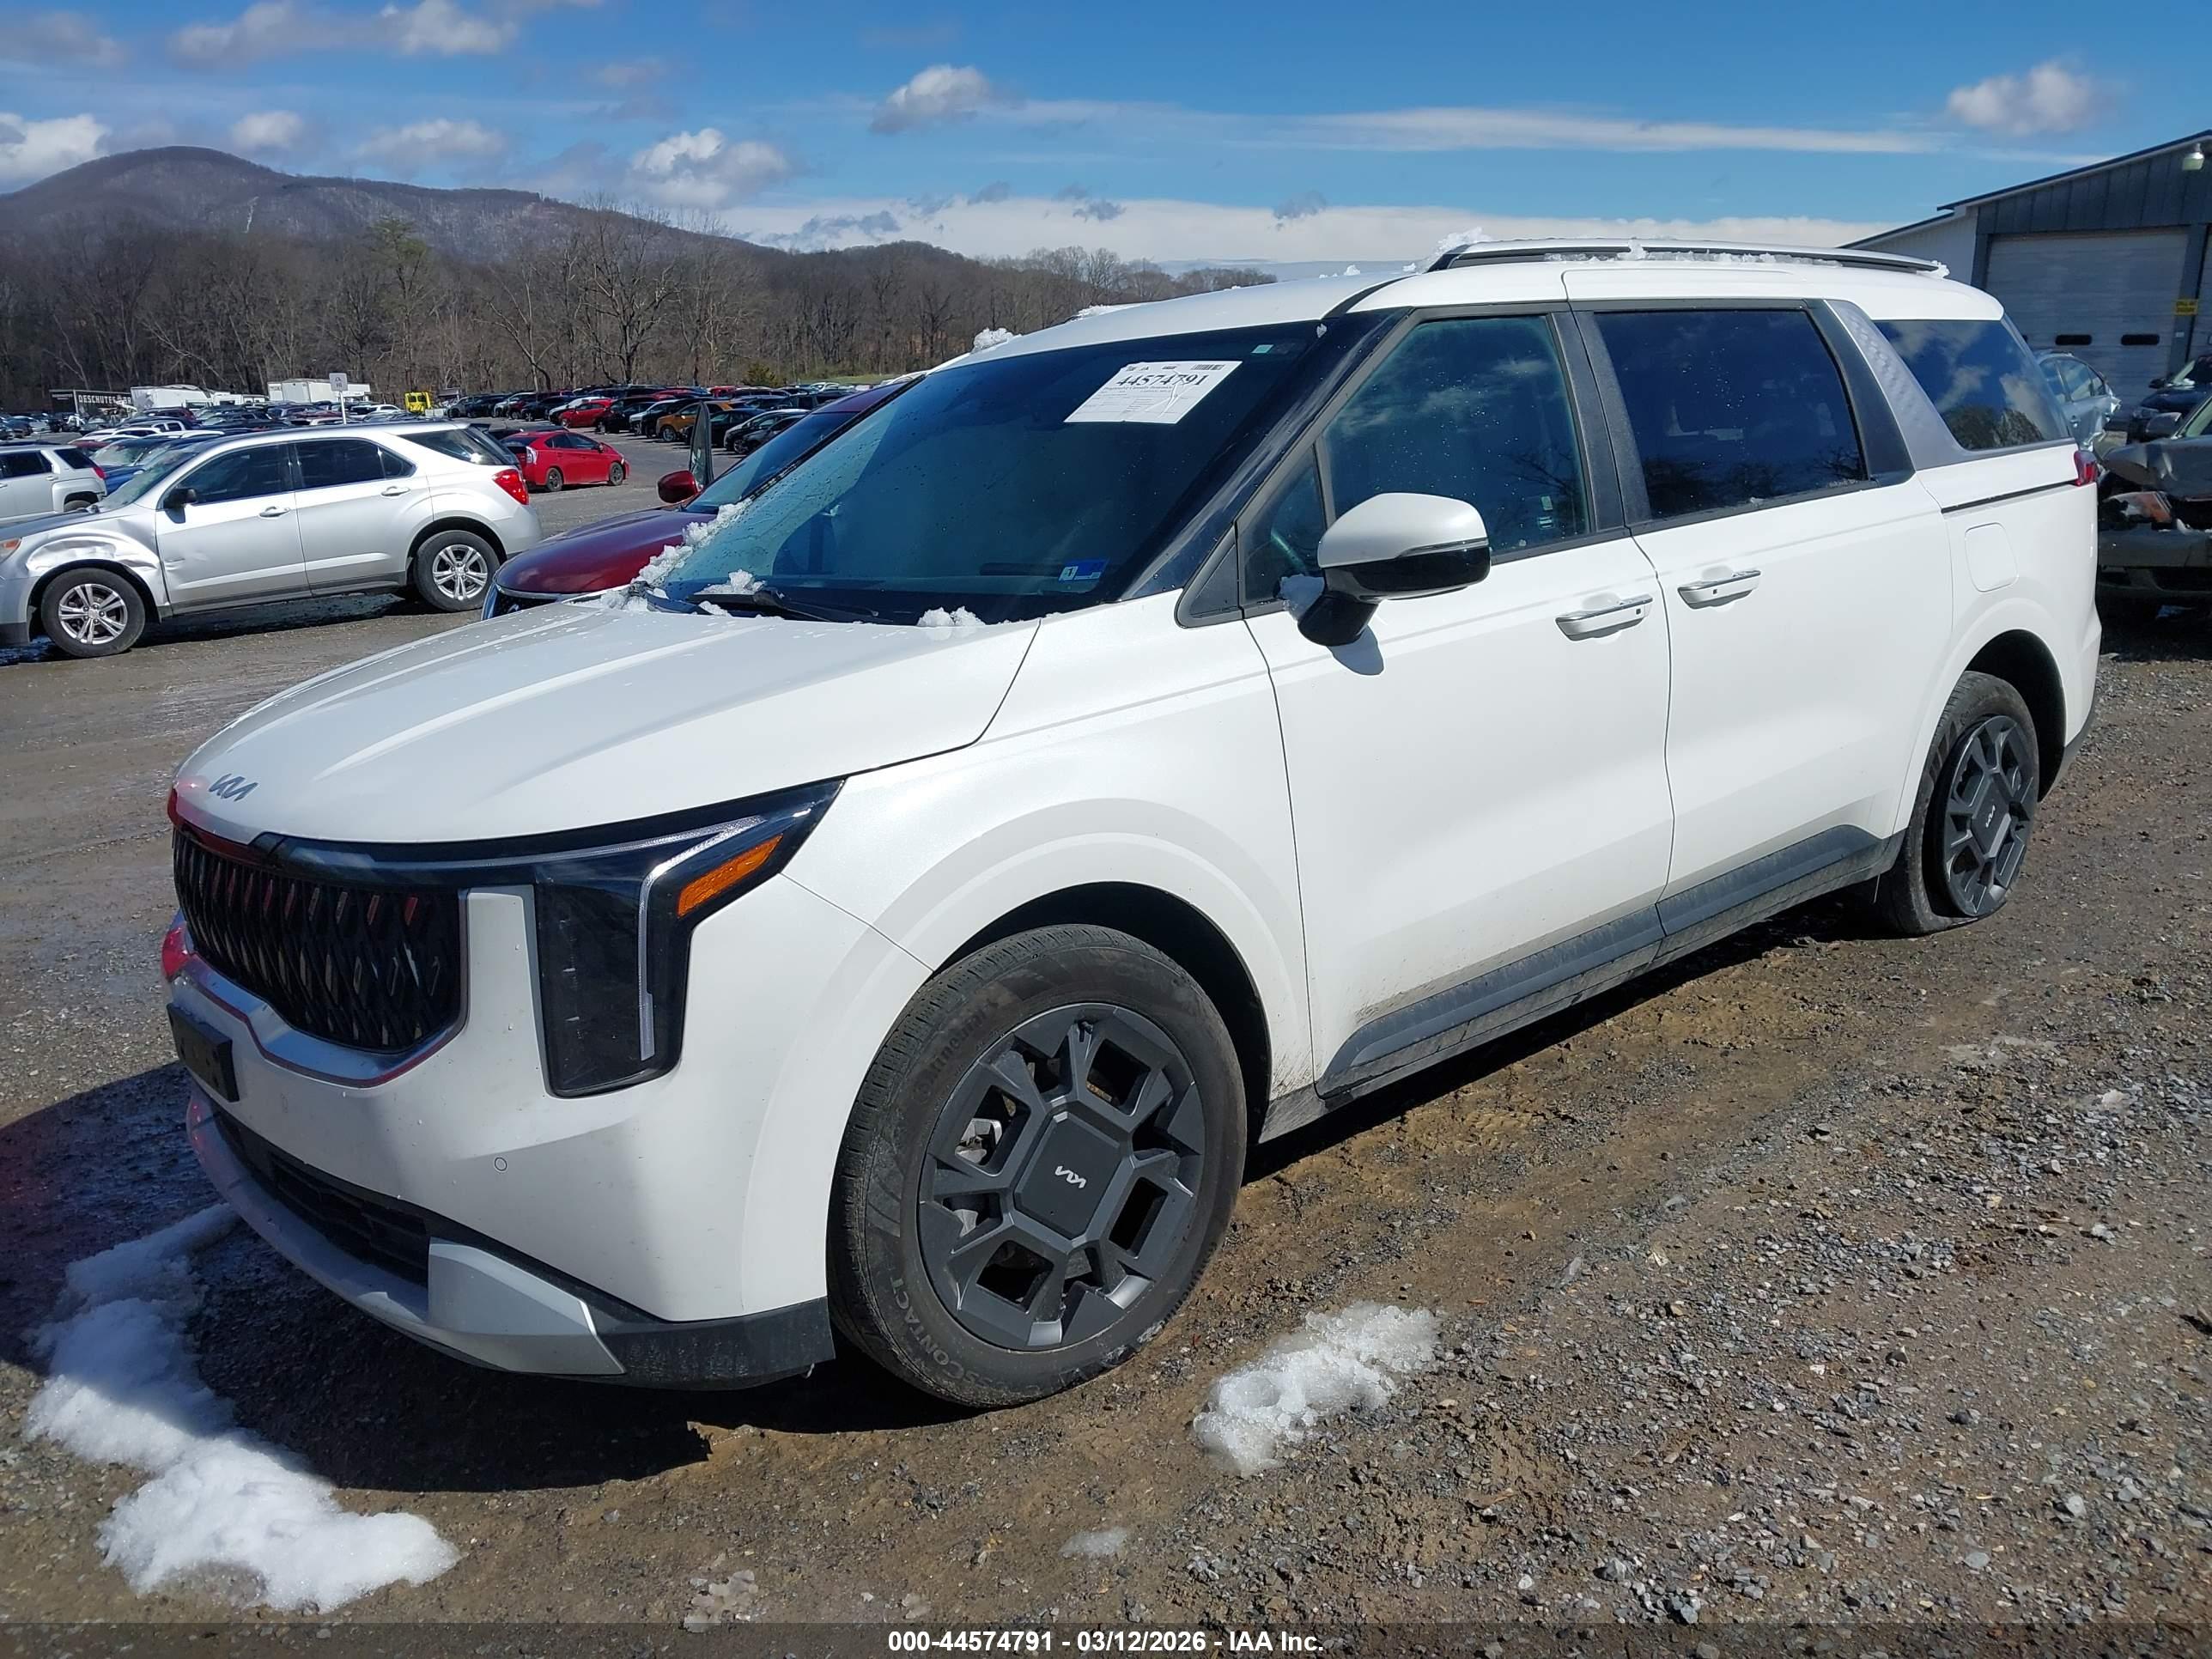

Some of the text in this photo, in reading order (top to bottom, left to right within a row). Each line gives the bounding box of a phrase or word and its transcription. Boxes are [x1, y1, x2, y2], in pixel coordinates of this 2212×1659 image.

[1116, 374, 1209, 386] 44574791
[78, 395, 117, 404] DESCHUTES
[209, 773, 258, 802] KIA
[1054, 1165, 1087, 1189] KIA
